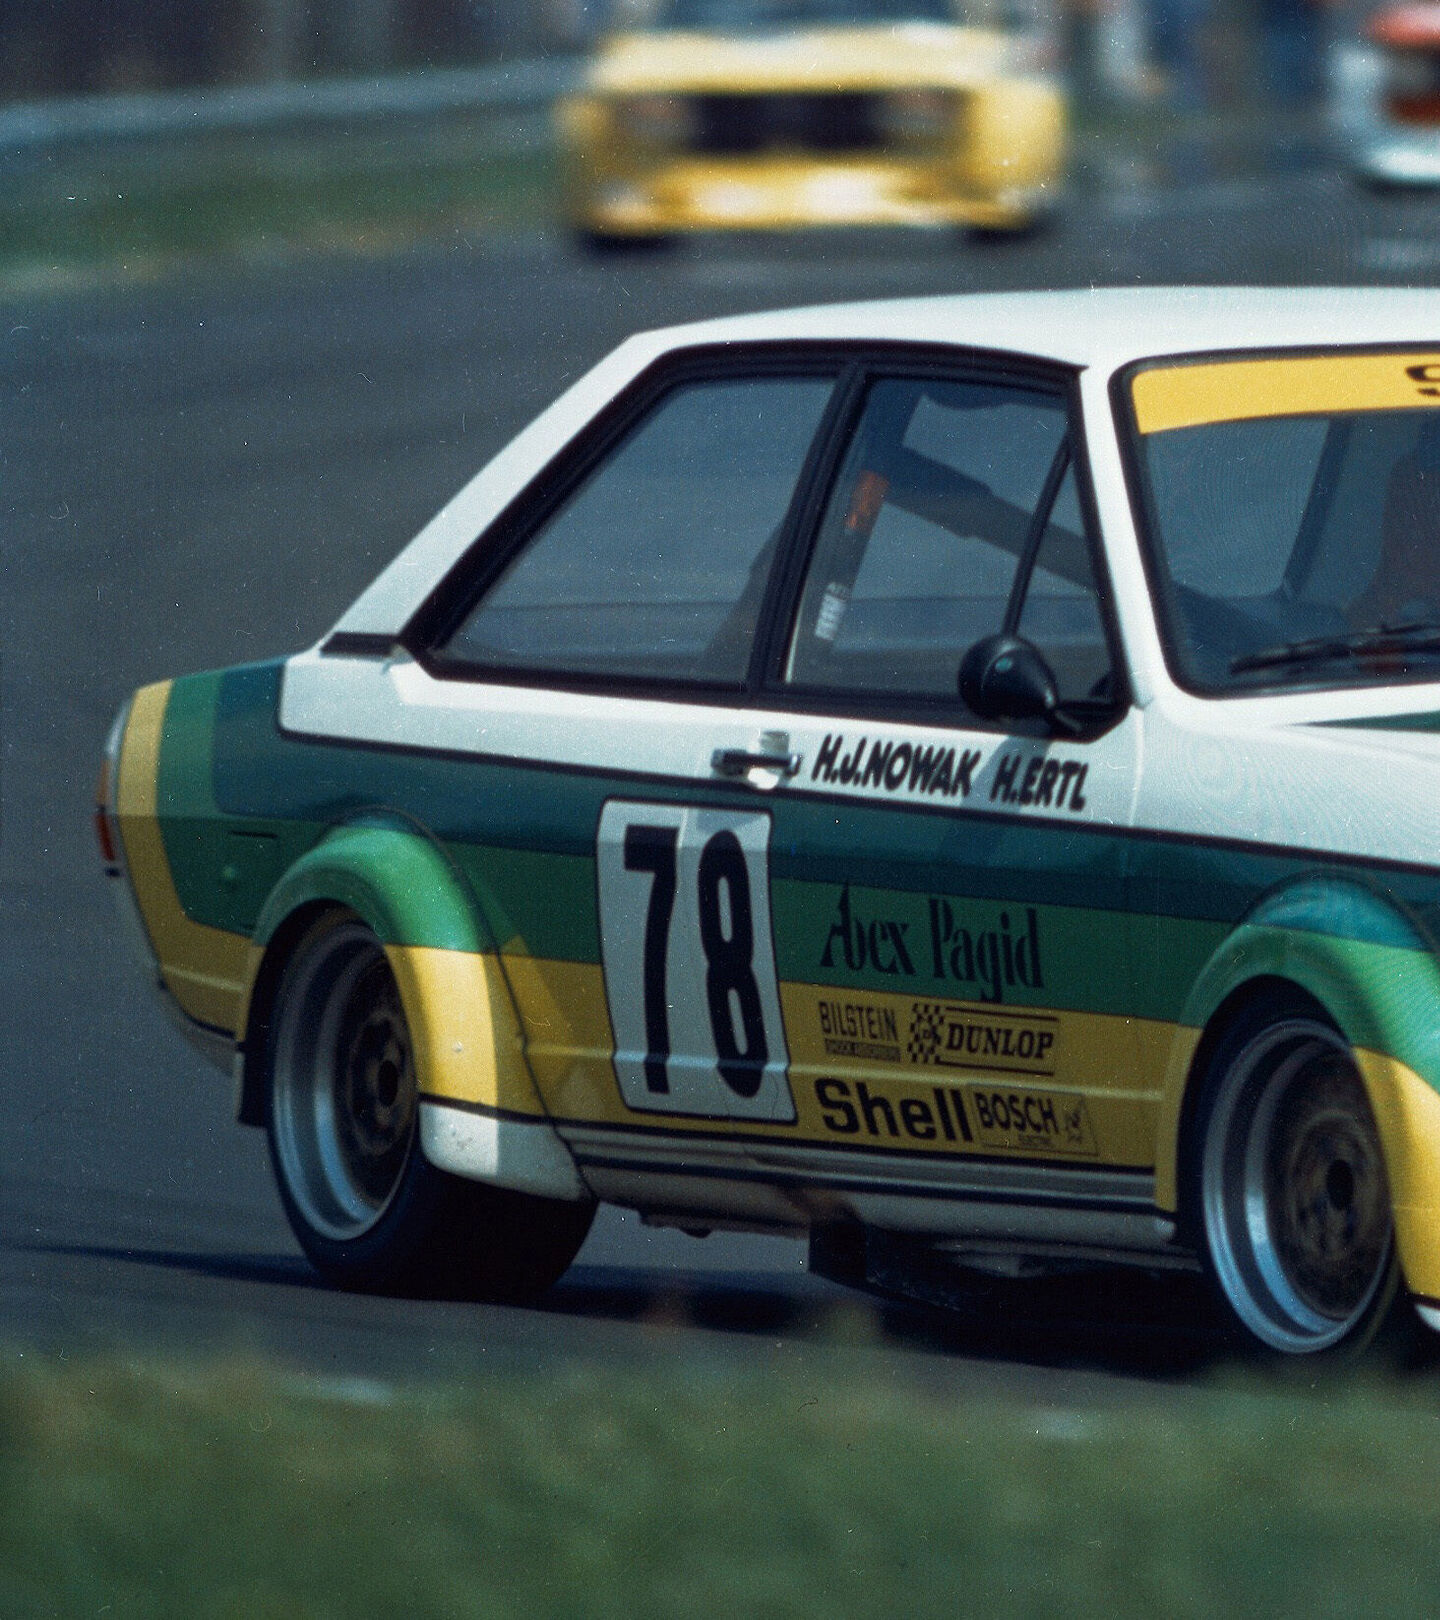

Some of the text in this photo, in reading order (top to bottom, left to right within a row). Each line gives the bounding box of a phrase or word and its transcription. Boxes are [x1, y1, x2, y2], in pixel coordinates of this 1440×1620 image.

[990, 754, 1089, 812] H.ERTL
[624, 825, 769, 1099] 78
[929, 898, 1045, 1004] Pagid
[818, 1001, 899, 1042] BILSTEIN
[945, 1022, 1054, 1060] DUNLOP
[814, 1077, 974, 1143] Shell
[974, 1091, 1059, 1134] BOSCH
